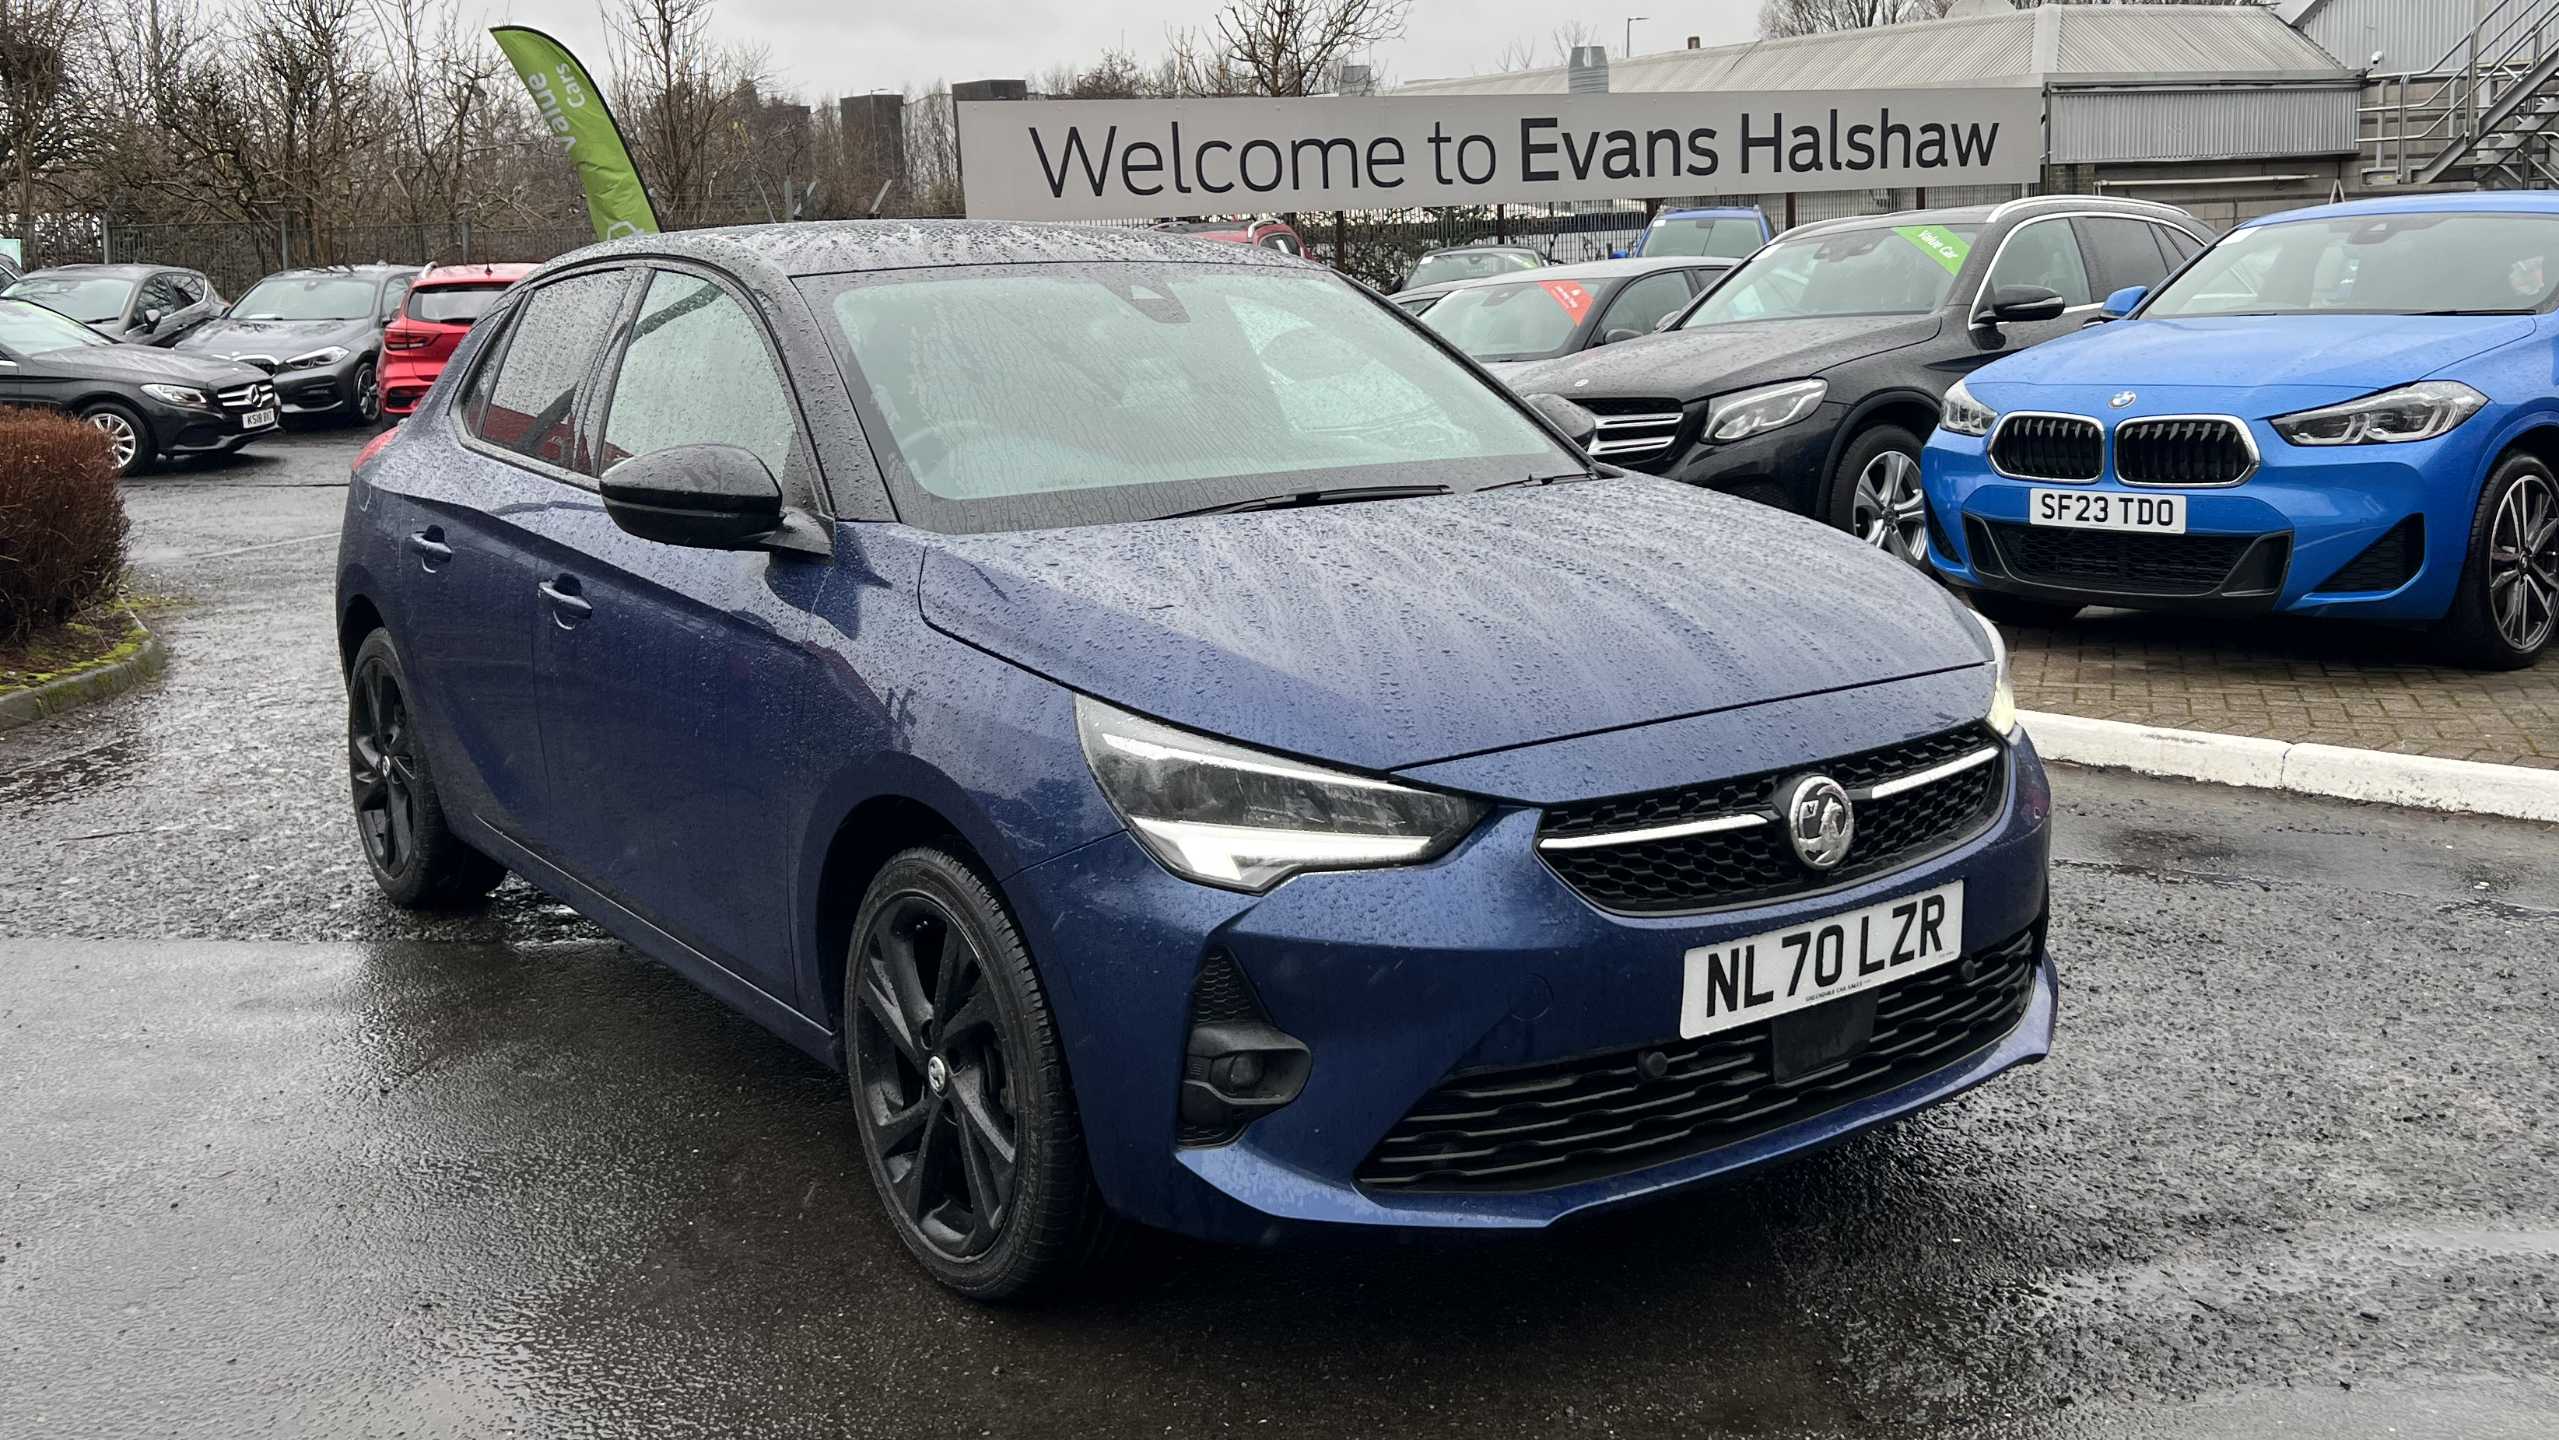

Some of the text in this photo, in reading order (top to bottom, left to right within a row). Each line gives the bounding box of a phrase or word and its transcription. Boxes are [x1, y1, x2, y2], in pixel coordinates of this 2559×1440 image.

[556, 63, 585, 108] Cars
[1028, 107, 2000, 198] Welcome to Evans Halshaw
[2041, 493, 2174, 526] SF23 TDO
[1706, 894, 1945, 1018] NL 70 LZR
